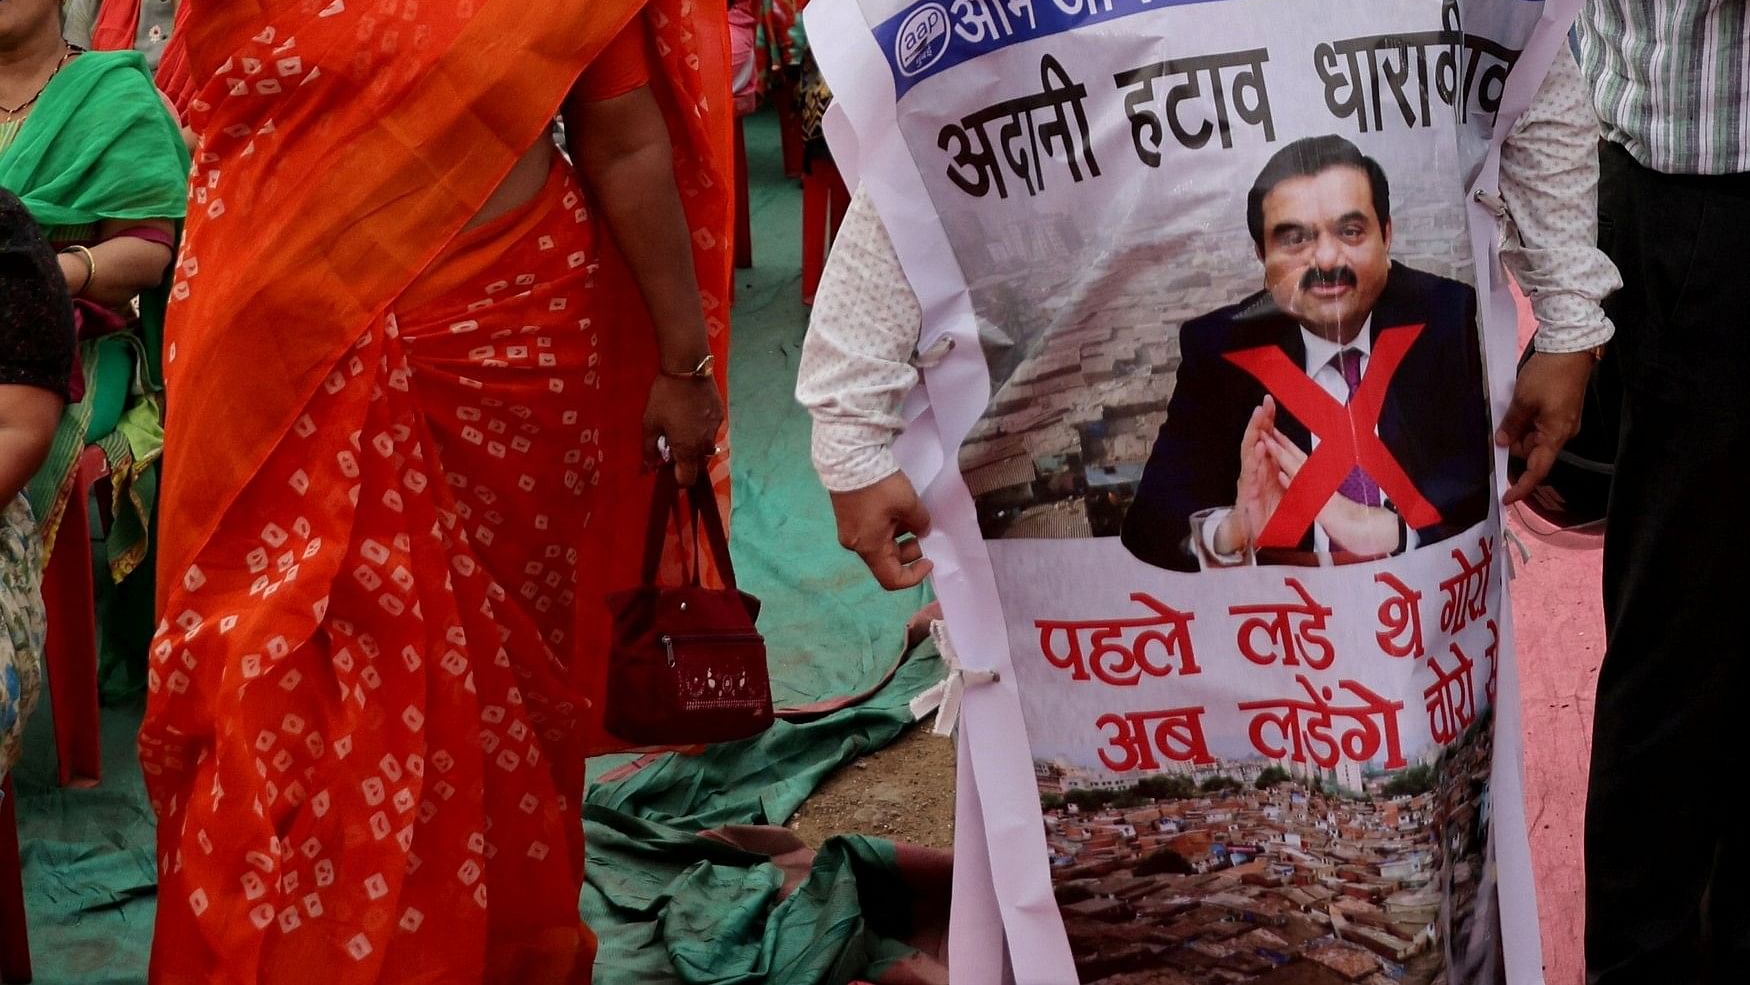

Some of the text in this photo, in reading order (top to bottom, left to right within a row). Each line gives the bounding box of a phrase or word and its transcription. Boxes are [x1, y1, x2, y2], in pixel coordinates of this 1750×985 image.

[905, 11, 939, 51] aap
[937, 53, 1103, 200] अदानी
[1114, 47, 1279, 168] हटाव
[1034, 592, 1201, 687] पहले
[1373, 572, 1425, 660] थे
[1096, 705, 1215, 773] अब
